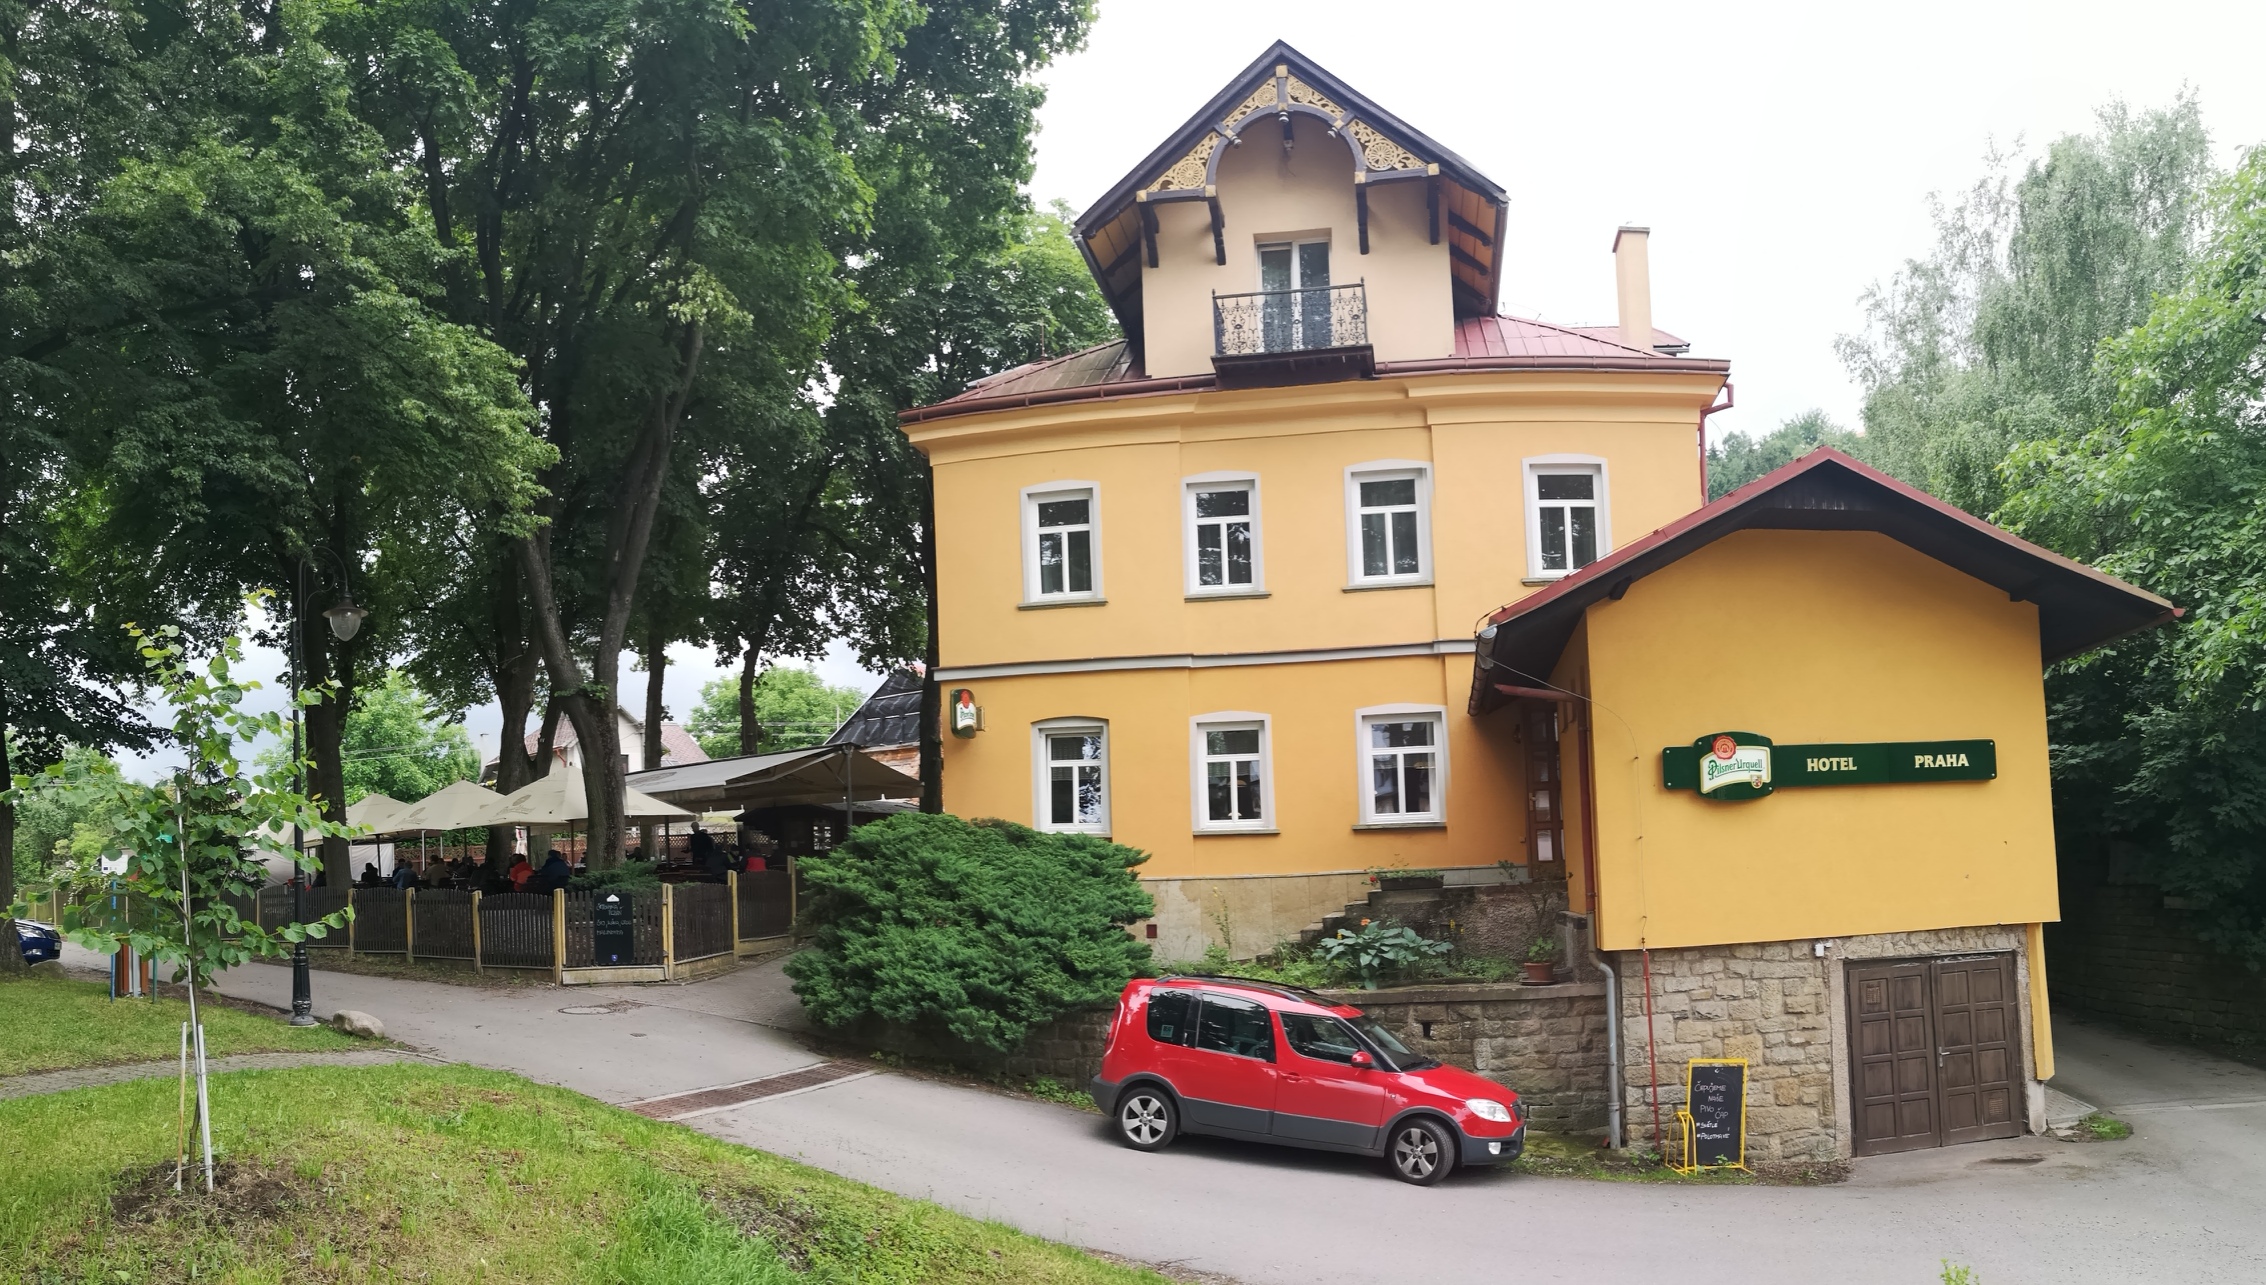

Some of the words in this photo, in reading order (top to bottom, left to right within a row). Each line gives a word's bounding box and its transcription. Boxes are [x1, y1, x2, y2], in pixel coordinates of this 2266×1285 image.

[1708, 759, 1736, 780] Pilsner
[1735, 758, 1762, 773] Urquell
[1806, 757, 1857, 772] HOTEL
[1914, 753, 1969, 768] PRAHA
